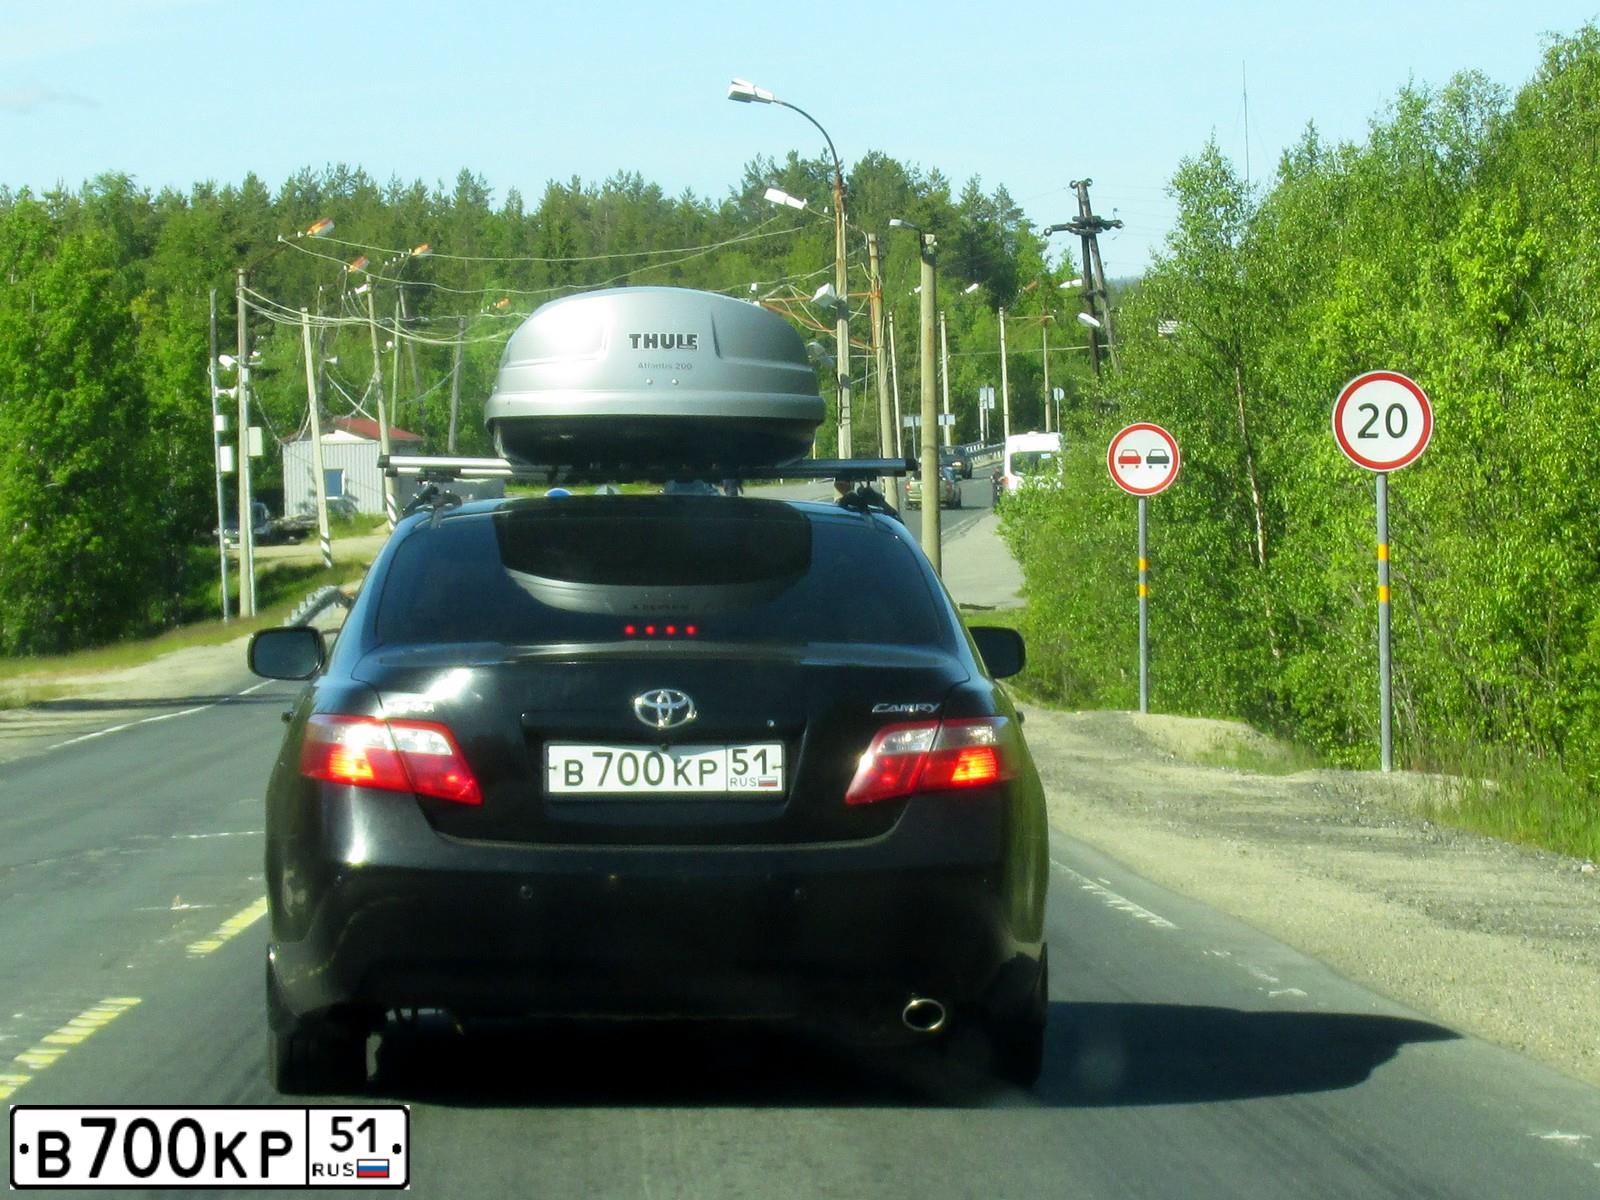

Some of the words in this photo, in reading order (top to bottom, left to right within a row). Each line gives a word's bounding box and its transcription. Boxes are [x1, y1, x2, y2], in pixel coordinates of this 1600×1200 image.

[629, 333, 698, 350] THULE
[675, 362, 693, 370] 200
[1357, 402, 1409, 439] 20
[871, 703, 941, 713] CAMRY
[731, 748, 768, 776] 51
[729, 777, 757, 787] RUS
